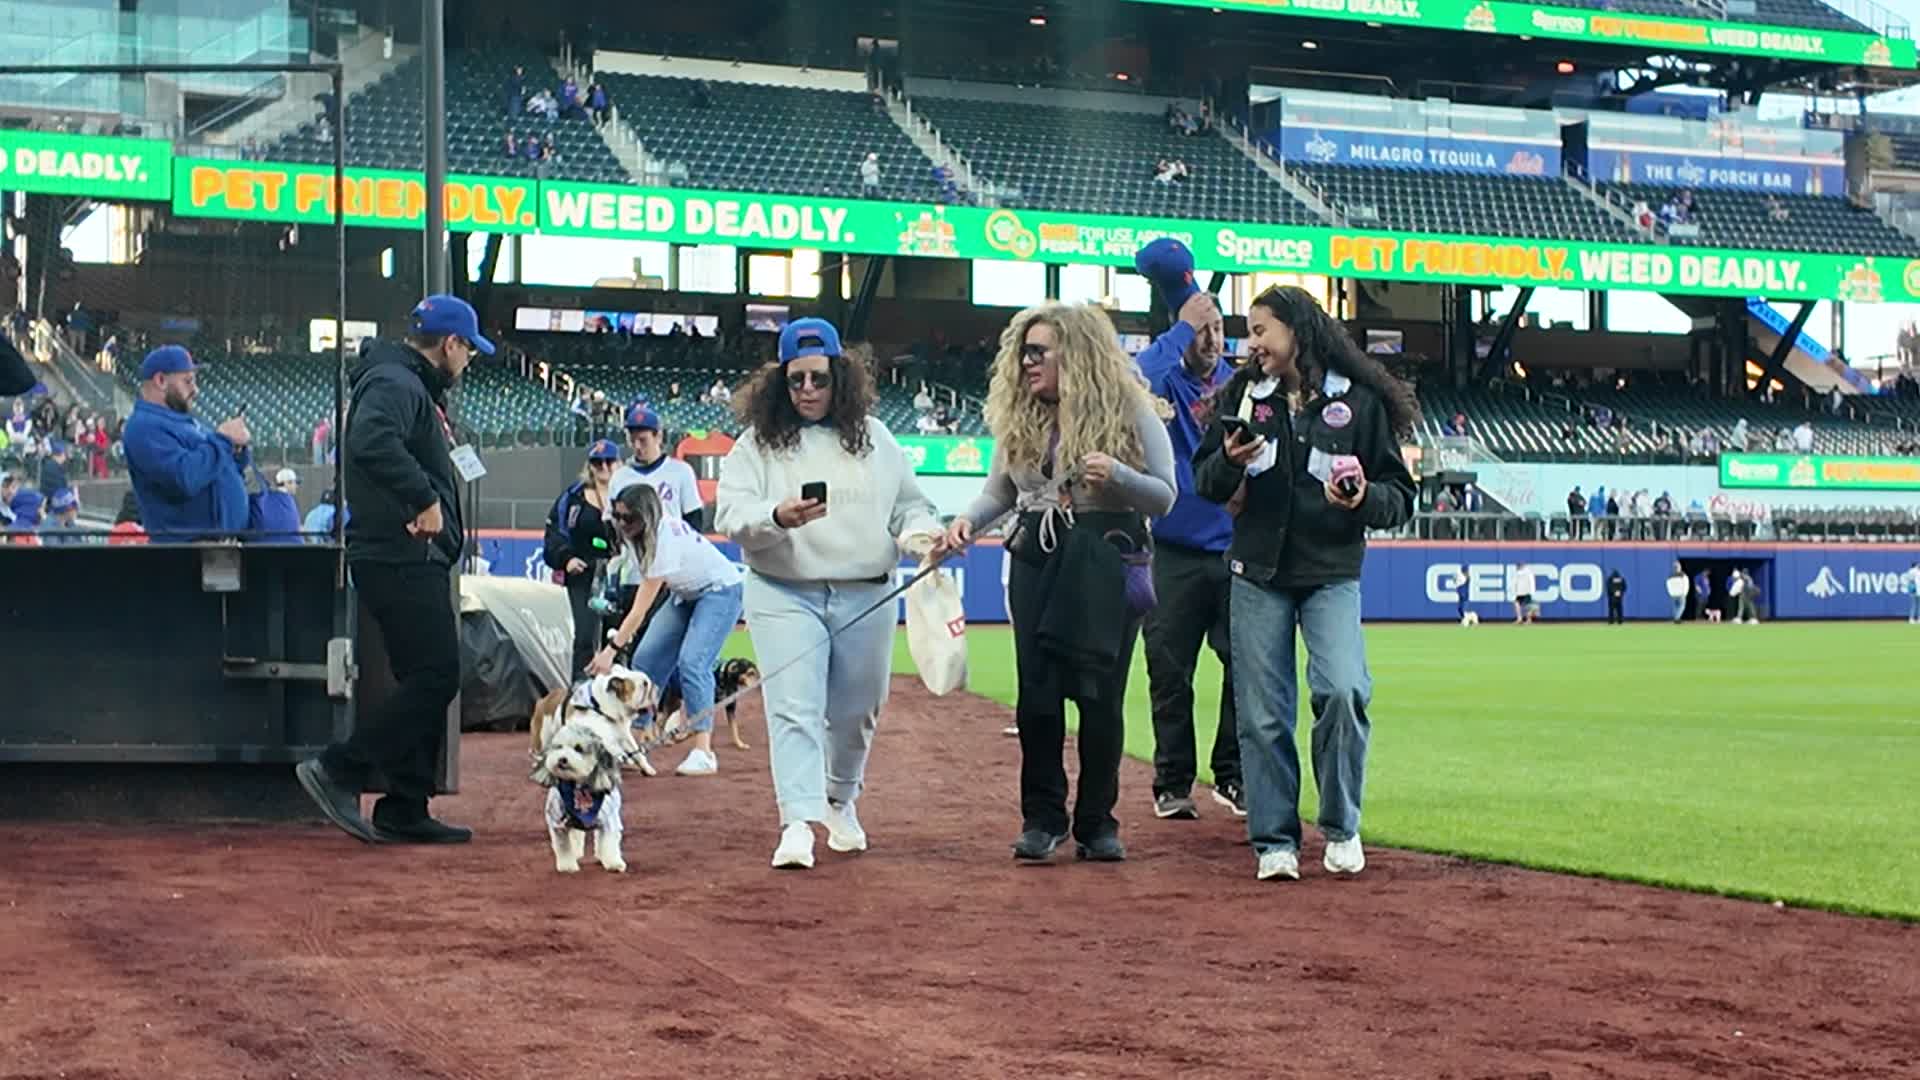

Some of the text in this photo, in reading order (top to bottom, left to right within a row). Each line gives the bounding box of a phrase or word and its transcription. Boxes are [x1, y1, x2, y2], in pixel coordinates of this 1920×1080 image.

[14, 147, 148, 182] DEADLY.
[1349, 144, 1424, 164] MILAGRO
[1430, 150, 1496, 169] TEQUILA
[190, 166, 287, 211] PET
[1645, 164, 1673, 181] THE
[1709, 170, 1759, 187] PORCH
[1763, 172, 1792, 188] BAR
[546, 189, 856, 243] WEED DEADLY.
[1078, 226, 1105, 241] FOR
[1107, 226, 1134, 243] USE
[1216, 228, 1312, 264] Spruce
[1330, 235, 1574, 280] PET FRIENDLY.
[1579, 249, 1807, 292] WEED DEADLY.
[1426, 563, 1603, 602] GEICO
